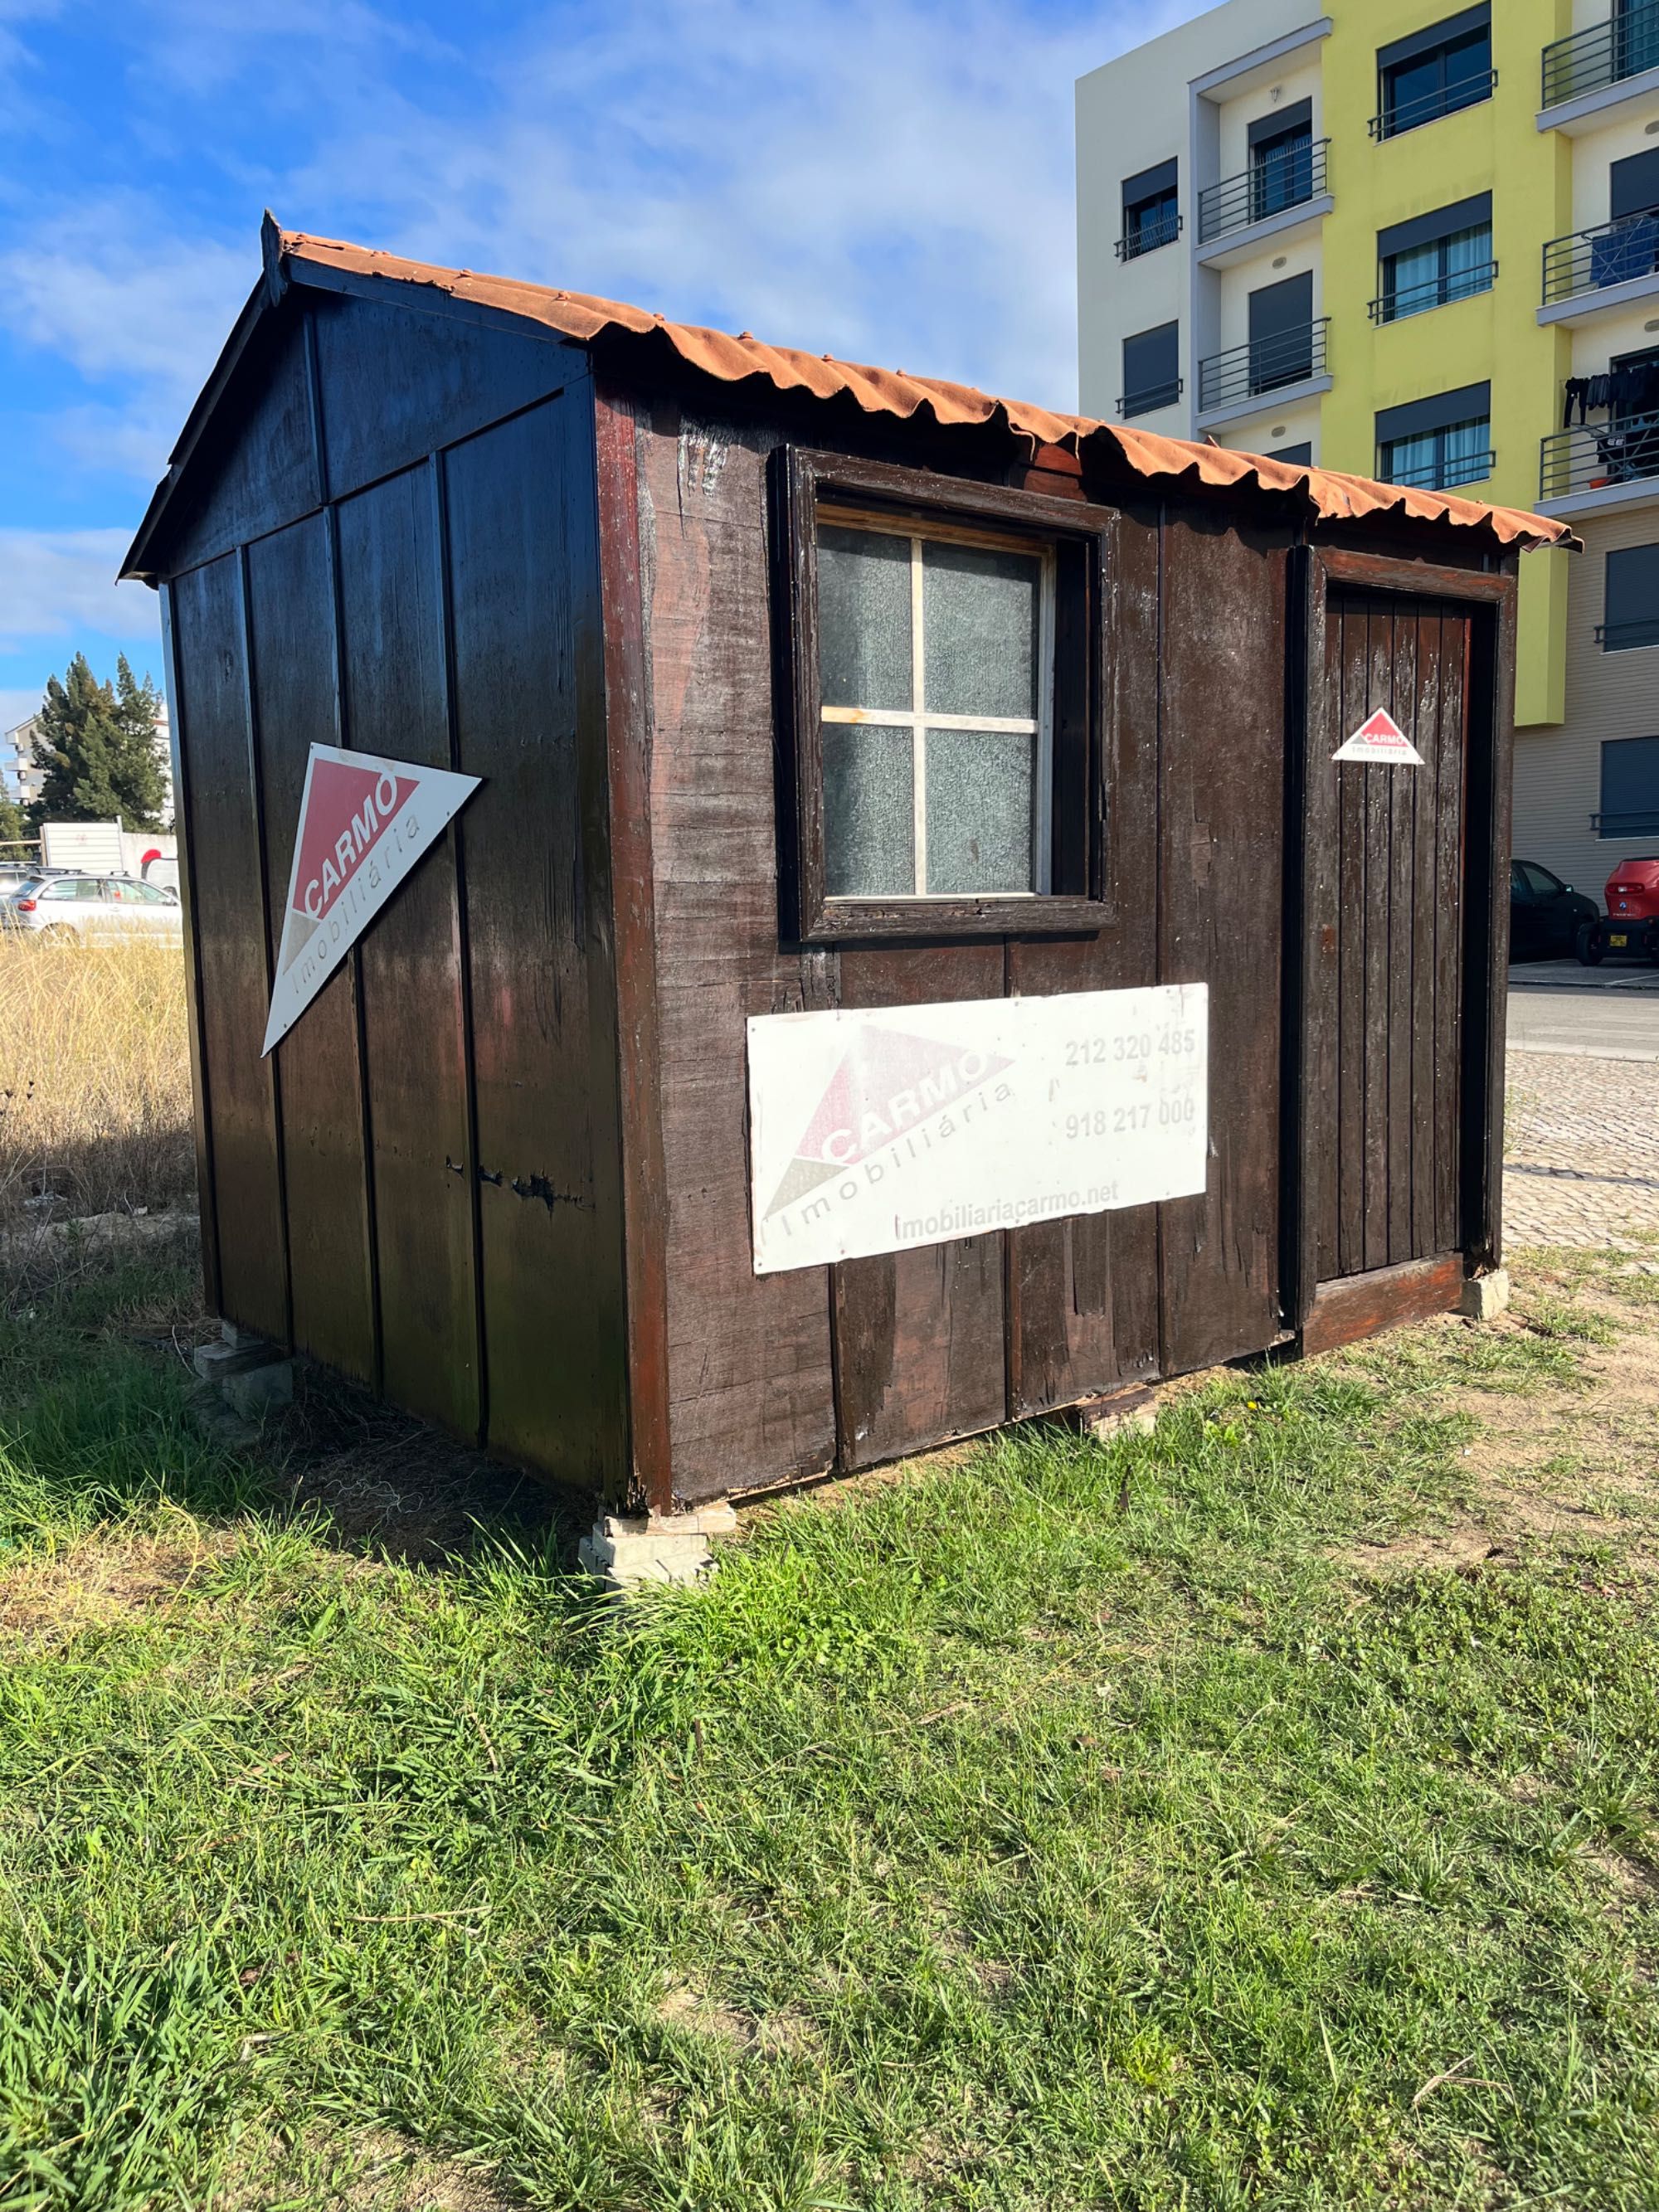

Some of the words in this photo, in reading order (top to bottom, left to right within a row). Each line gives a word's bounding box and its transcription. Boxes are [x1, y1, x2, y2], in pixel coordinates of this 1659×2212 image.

[1365, 732, 1404, 745] CARMO
[304, 771, 397, 914] CARMO
[1065, 1038, 1106, 1066] 212
[1113, 1033, 1151, 1061] 320
[1158, 1028, 1194, 1055] 485
[821, 1049, 990, 1163] CARMO
[1065, 1111, 1106, 1139] 918
[1113, 1103, 1151, 1132] 217
[1158, 1096, 1194, 1125] 000
[781, 1083, 1011, 1236] Imobiliária
